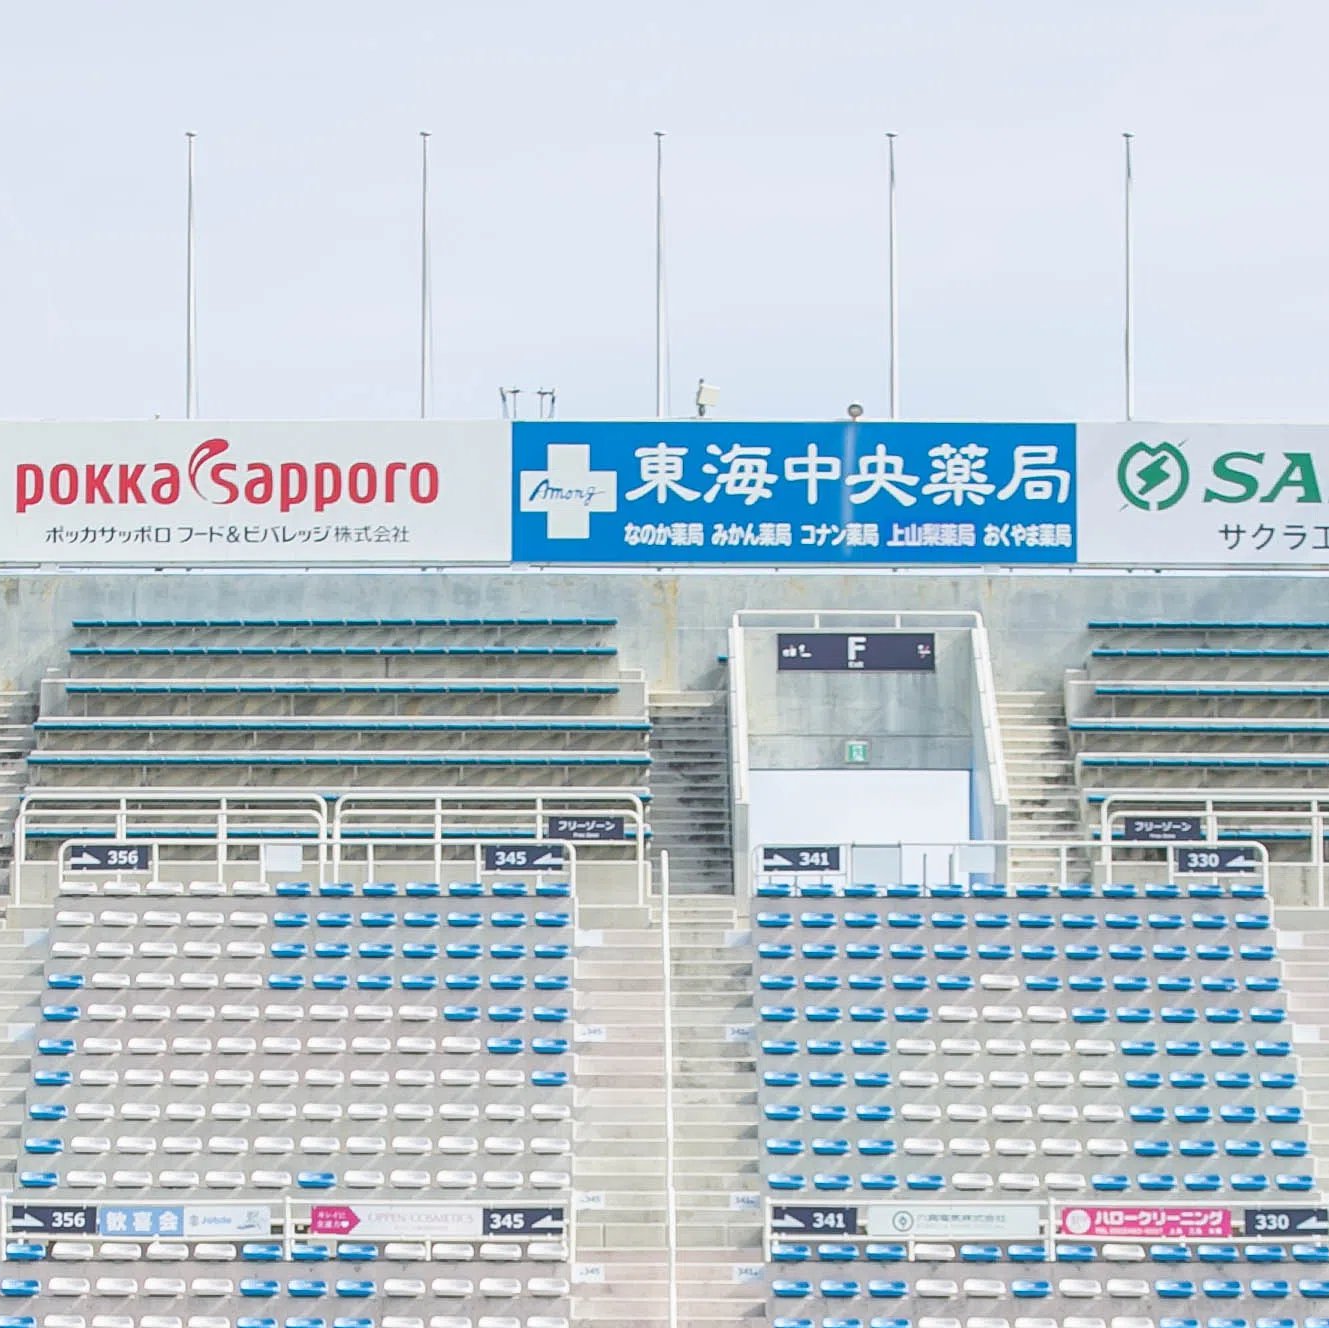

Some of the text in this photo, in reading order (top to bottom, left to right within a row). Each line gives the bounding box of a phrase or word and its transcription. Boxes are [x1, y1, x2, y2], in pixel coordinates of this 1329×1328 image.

[625, 442, 1070, 505] 東海中央薬局
[712, 523, 792, 546] みかん薬局
[801, 520, 879, 546] コナン薬局
[984, 524, 1072, 547] おくやま薬局
[848, 636, 866, 660] F
[558, 821, 615, 831] フリーゾーン
[1135, 821, 1191, 831] フリーゾーン
[107, 850, 138, 865] 356
[495, 851, 527, 866] 345
[798, 852, 830, 866] 341
[1187, 853, 1219, 868] 330
[52, 1212, 85, 1227] 356
[490, 1214, 524, 1229] 345
[813, 1213, 845, 1228] 341
[1095, 1209, 1223, 1225] ハロークリーニング
[1255, 1214, 1289, 1230] 330
